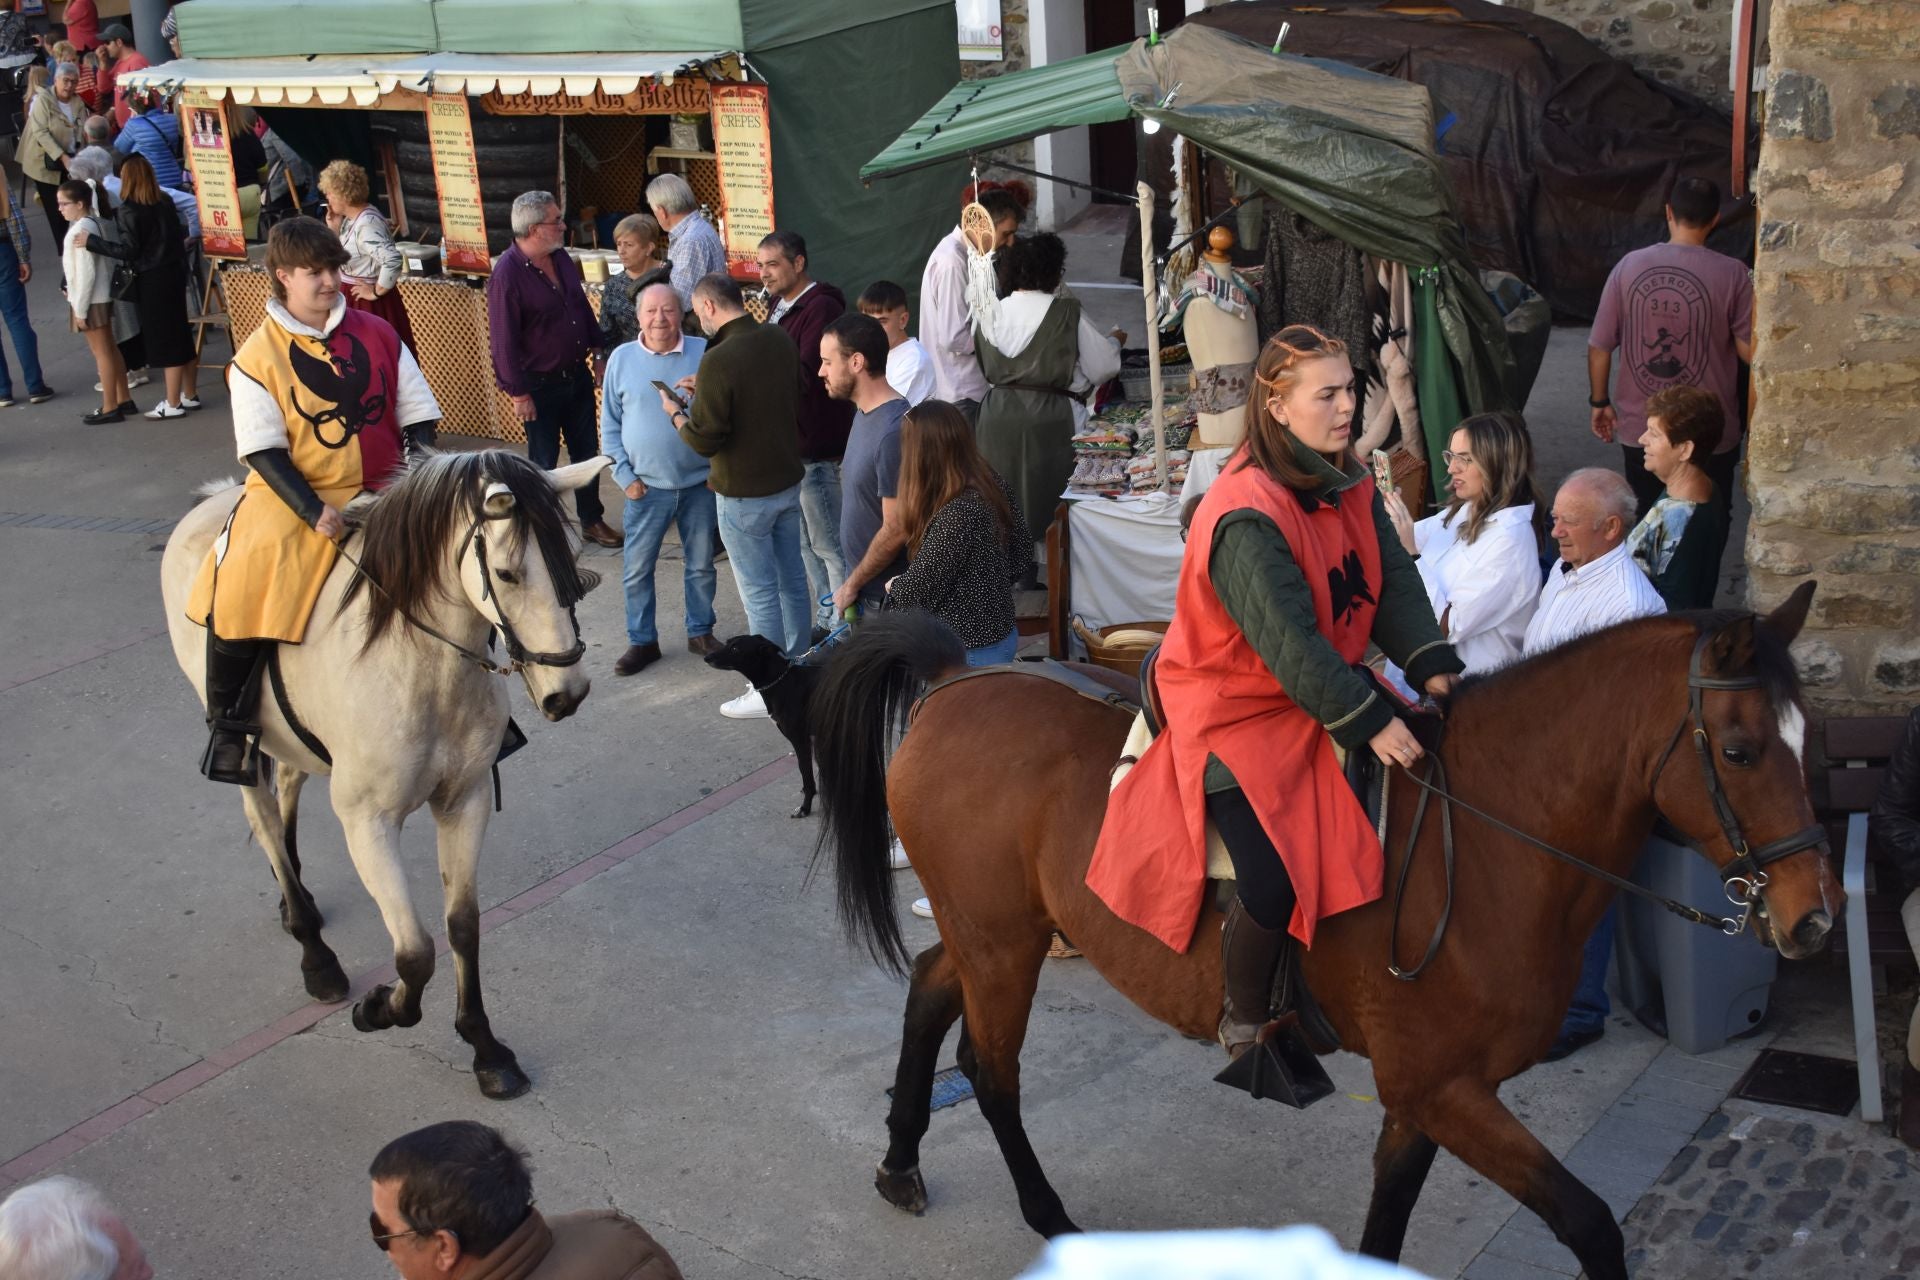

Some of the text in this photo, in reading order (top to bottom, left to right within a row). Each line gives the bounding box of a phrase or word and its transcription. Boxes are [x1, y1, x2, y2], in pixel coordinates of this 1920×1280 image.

[432, 103, 466, 117] CREPES
[721, 114, 760, 128] CREPES
[1643, 276, 1697, 297] DETROIT
[1651, 298, 1681, 314] 313
